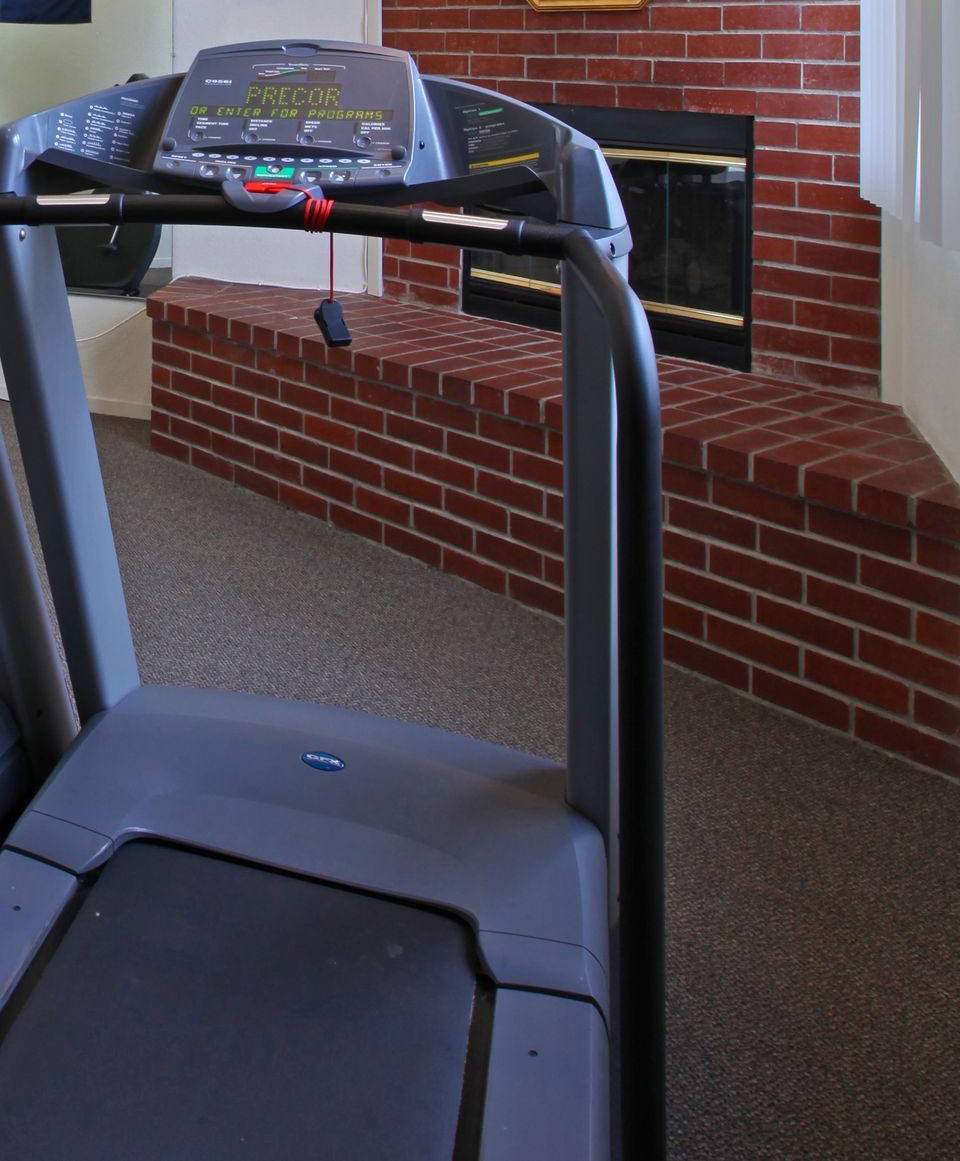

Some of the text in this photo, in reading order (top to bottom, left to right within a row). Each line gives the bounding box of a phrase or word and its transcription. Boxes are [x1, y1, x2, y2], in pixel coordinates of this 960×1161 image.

[246, 86, 341, 107] PRECOR
[189, 105, 384, 121] OR ENTER FOR PROGRAMS
